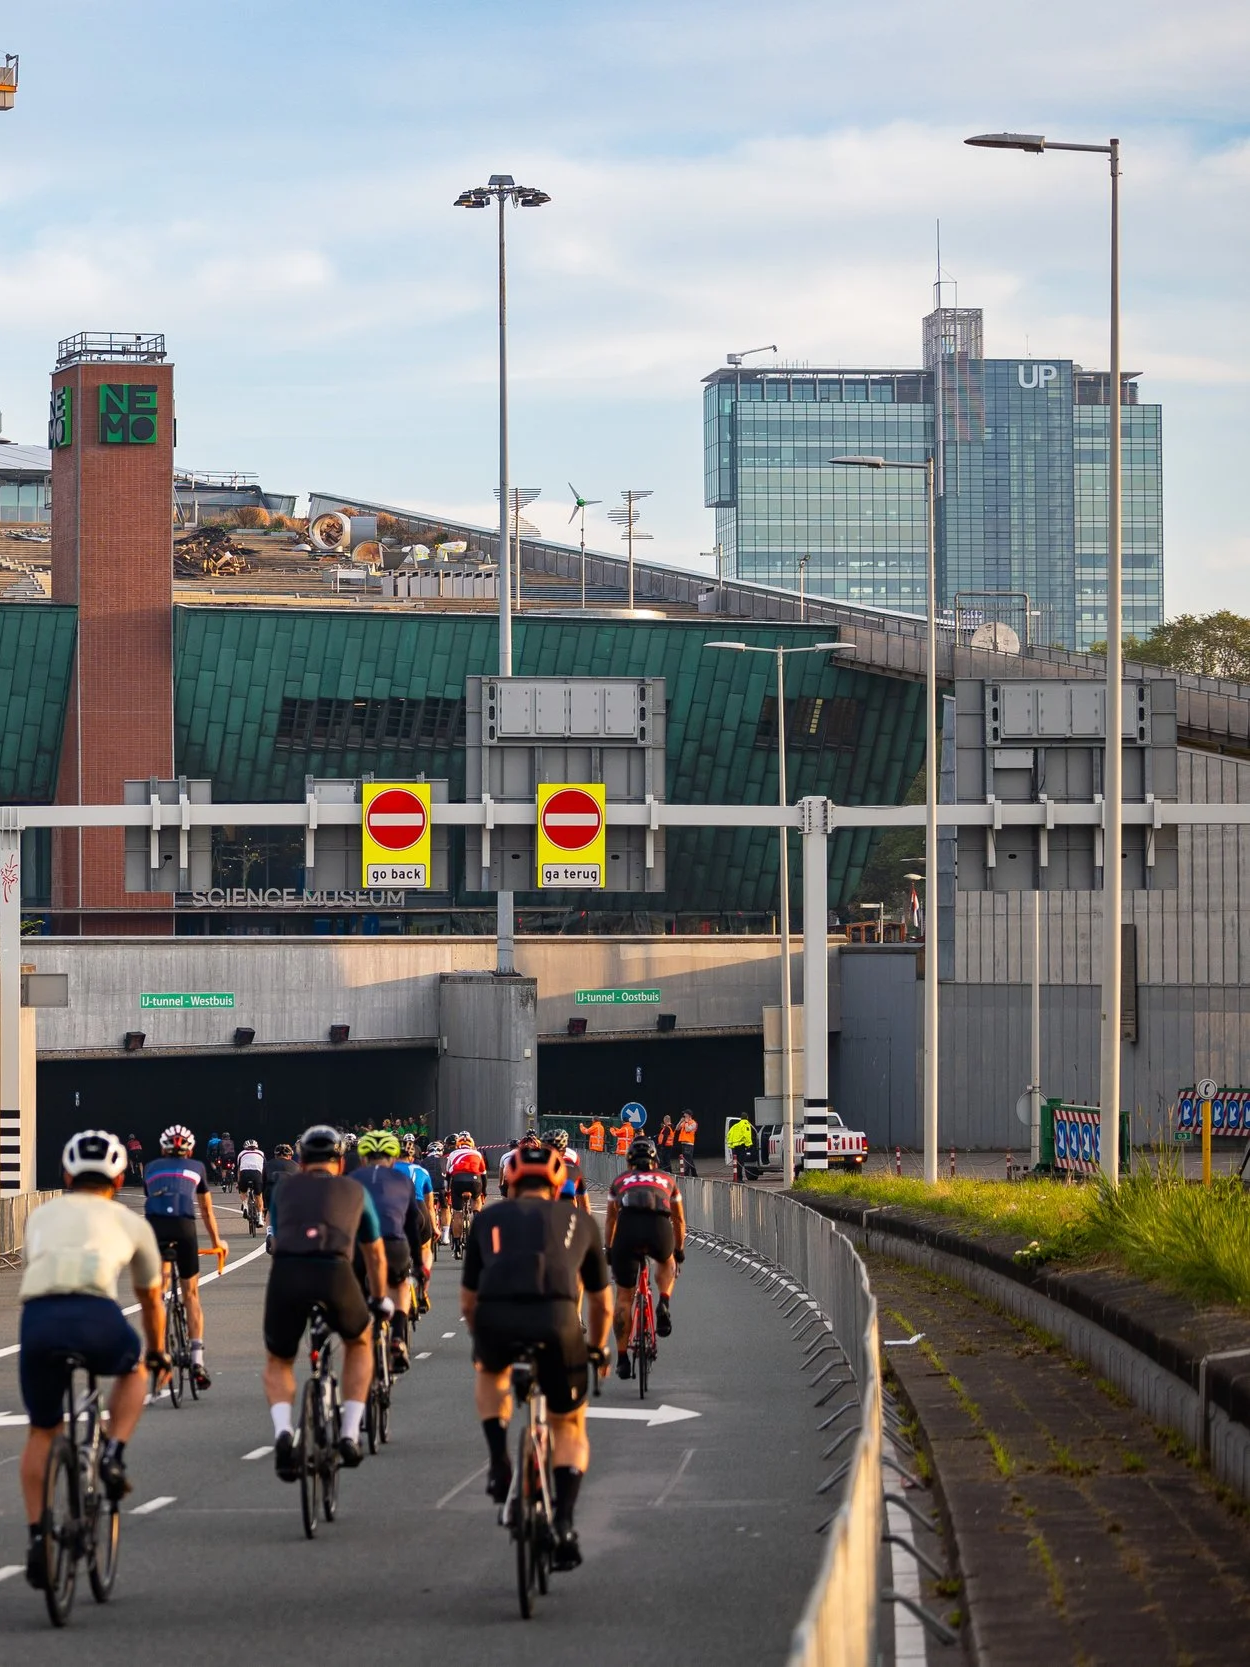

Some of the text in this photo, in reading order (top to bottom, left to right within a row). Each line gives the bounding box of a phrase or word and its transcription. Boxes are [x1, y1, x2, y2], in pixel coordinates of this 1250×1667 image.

[1018, 364, 1058, 389] UP
[372, 867, 421, 882] go back
[545, 867, 597, 882] ga terug
[192, 887, 405, 908] SCIENCE MUSEUM
[142, 995, 184, 1006] IJ-tunnel
[190, 995, 233, 1006] Westbuis
[577, 992, 615, 1002] IJ-tunnel
[621, 992, 660, 1002] Oostbuis
